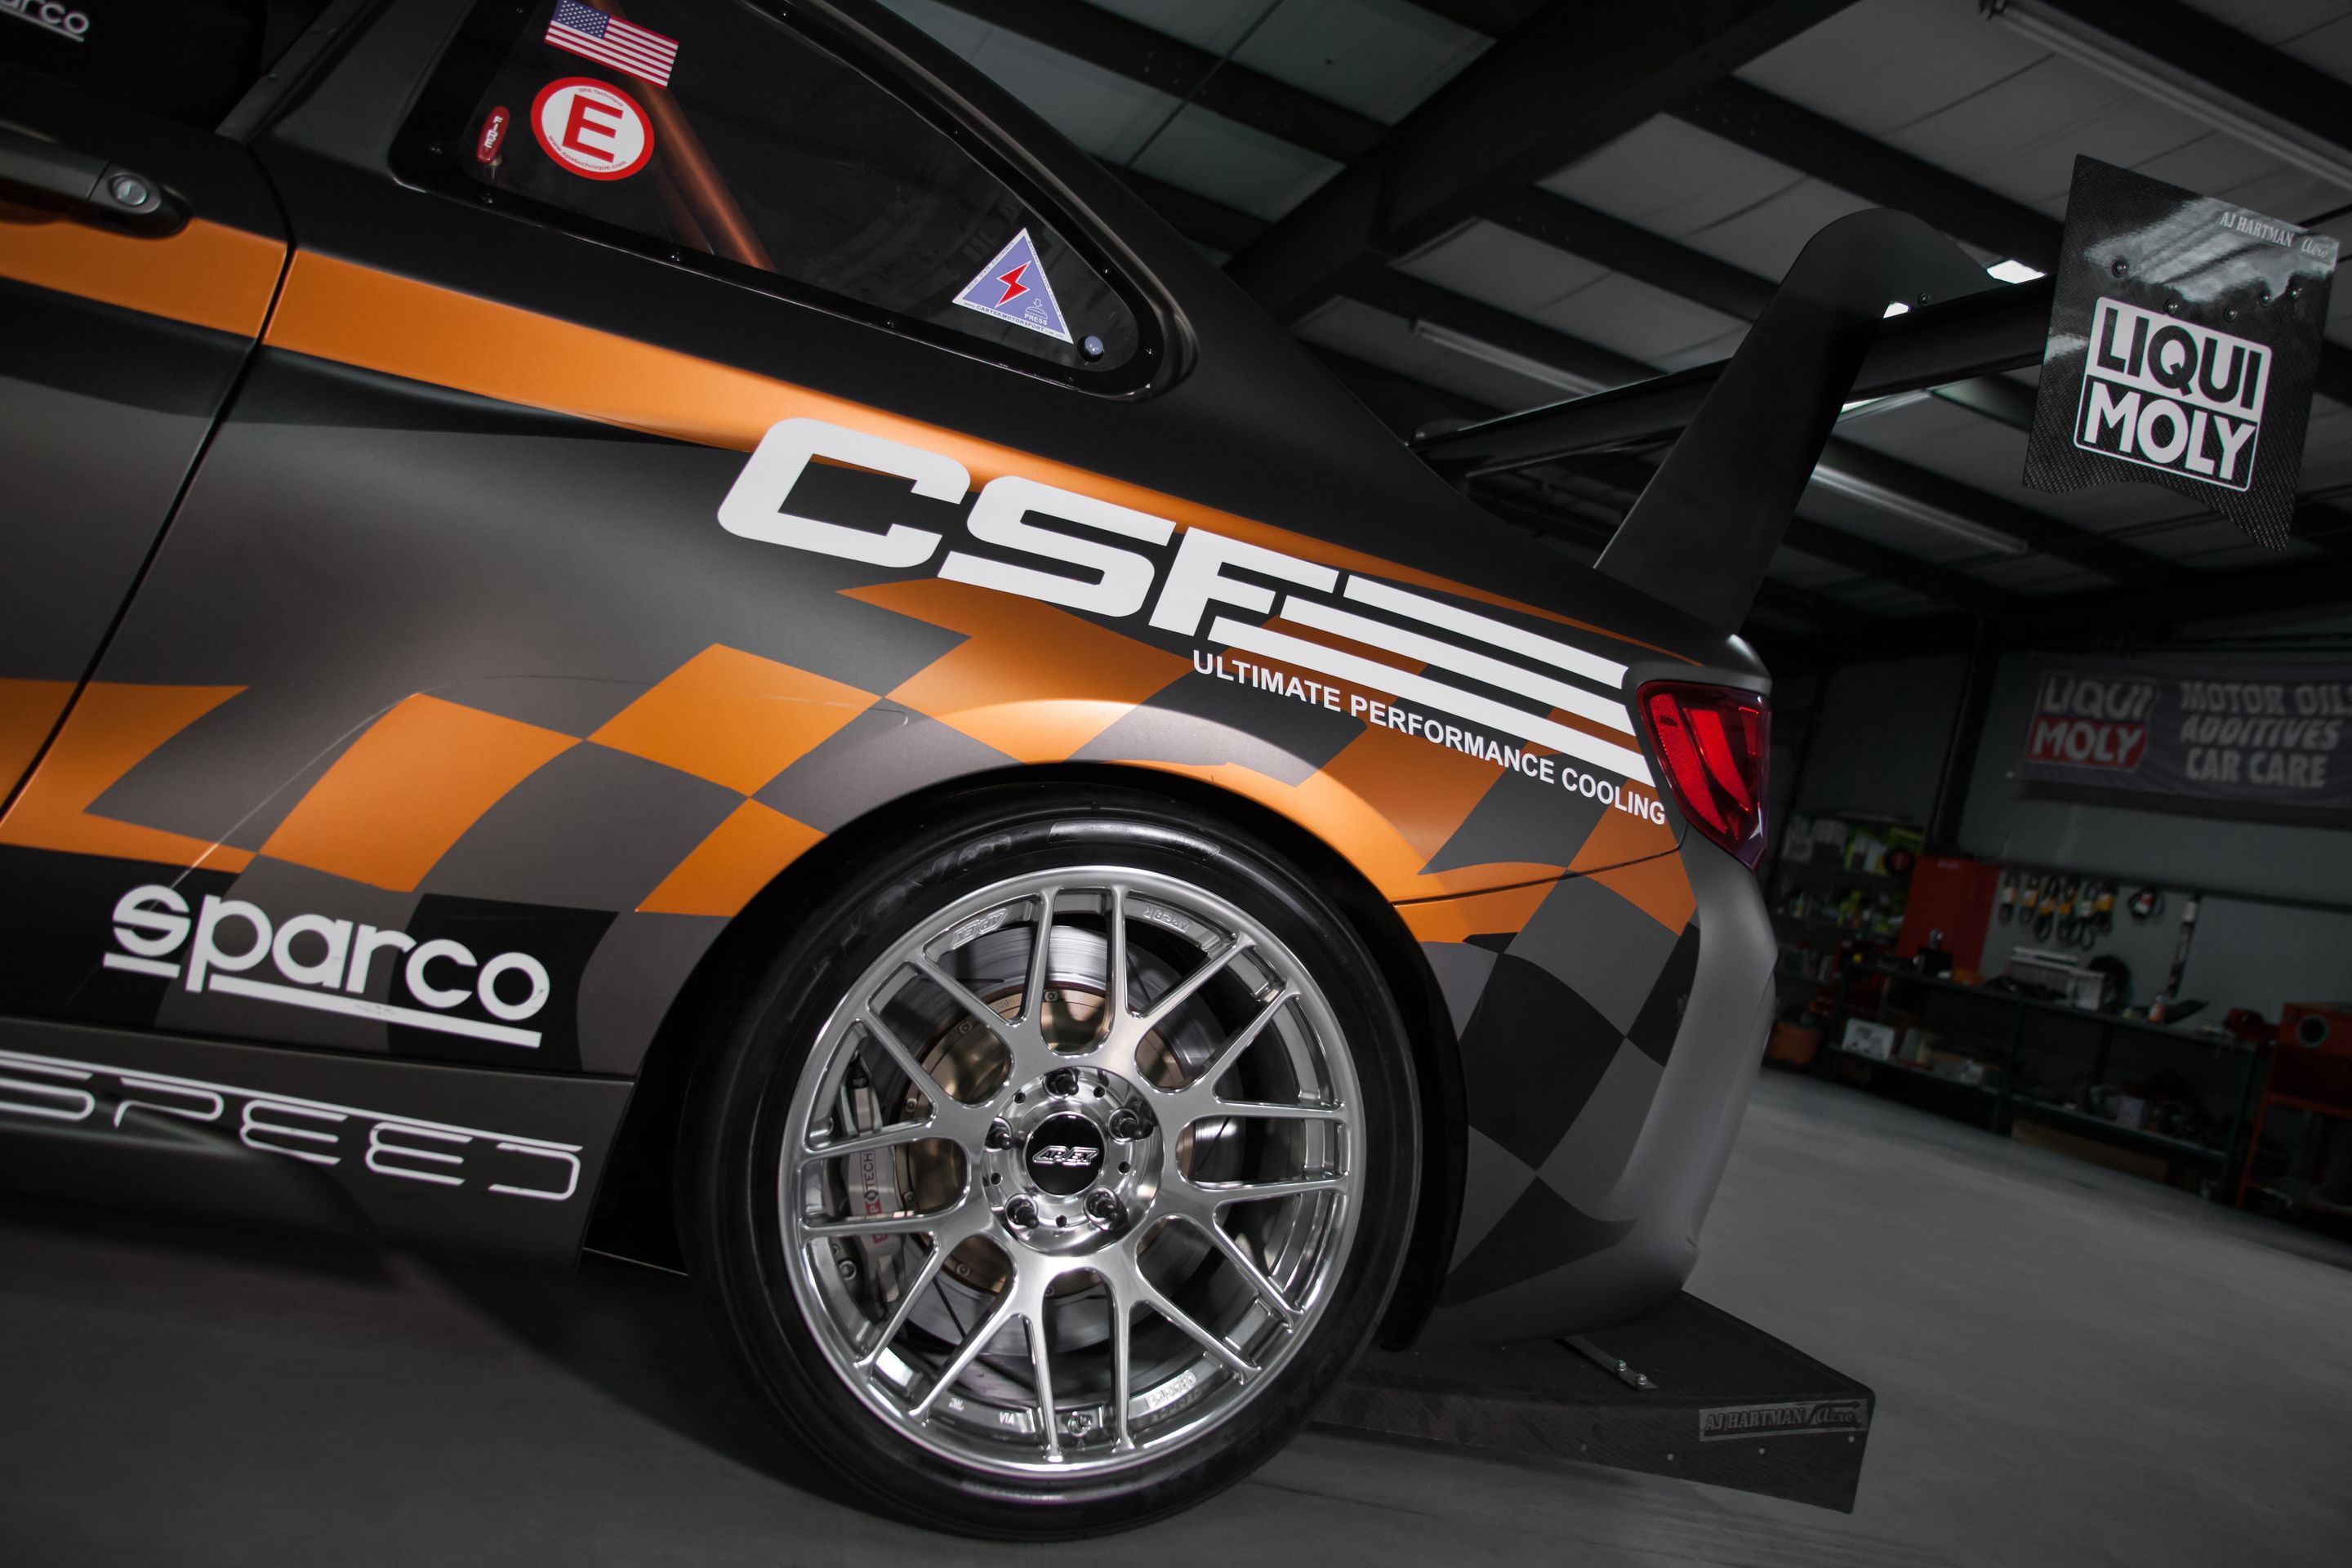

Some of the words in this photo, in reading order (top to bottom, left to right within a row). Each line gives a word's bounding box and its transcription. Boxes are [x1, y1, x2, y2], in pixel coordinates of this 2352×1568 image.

[594, 89, 624, 108] Technique
[484, 115, 503, 149] FIRE
[561, 93, 624, 164] E
[2219, 211, 2238, 228] AJ
[2236, 216, 2295, 247] HARTMAN
[1024, 313, 1048, 326] PRESS
[2096, 306, 2263, 411] LIQUI
[2083, 380, 2256, 480] MOLY
[717, 417, 1339, 636] CSF
[2041, 675, 2154, 719] LIQUI
[2179, 680, 2286, 715] MOTOR
[1192, 649, 1341, 711] ULTIMATE
[1350, 693, 1555, 784] PERFORMANCE
[1561, 767, 1666, 825] COOLING
[2032, 719, 2145, 764] MOLY
[2179, 715, 2342, 751] ADDITIVES
[2185, 747, 2242, 783] CAR
[2247, 751, 2329, 788] CARE
[111, 884, 550, 1022] sparco
[999, 1411, 1014, 1425] VIA
[1704, 1413, 1726, 1432] AJ
[1726, 1407, 1805, 1429] HARTMAN
